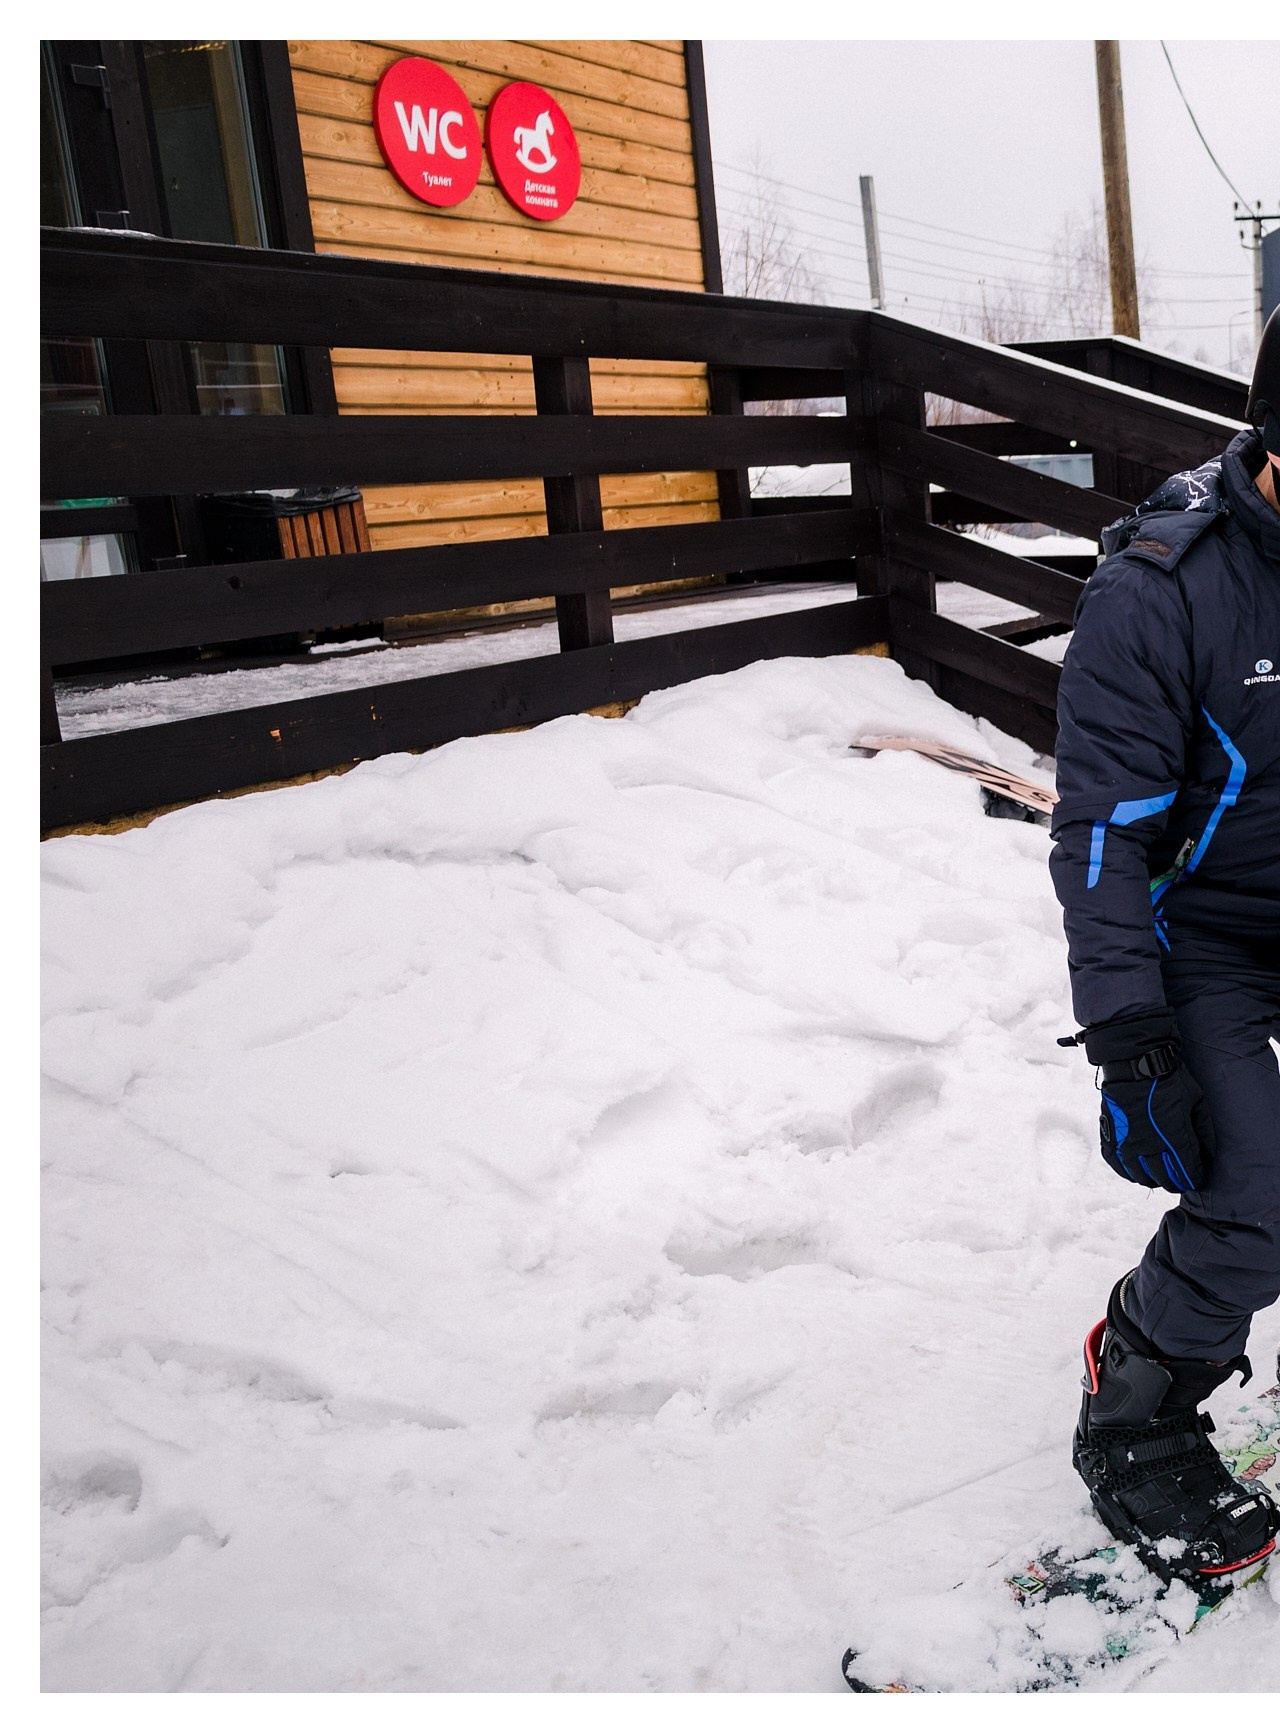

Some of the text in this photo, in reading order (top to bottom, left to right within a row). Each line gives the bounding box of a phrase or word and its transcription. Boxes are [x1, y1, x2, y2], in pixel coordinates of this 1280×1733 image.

[394, 101, 467, 160] WC
[422, 171, 453, 187] Туалет
[524, 179, 556, 195] Детская
[525, 195, 559, 209] комната
